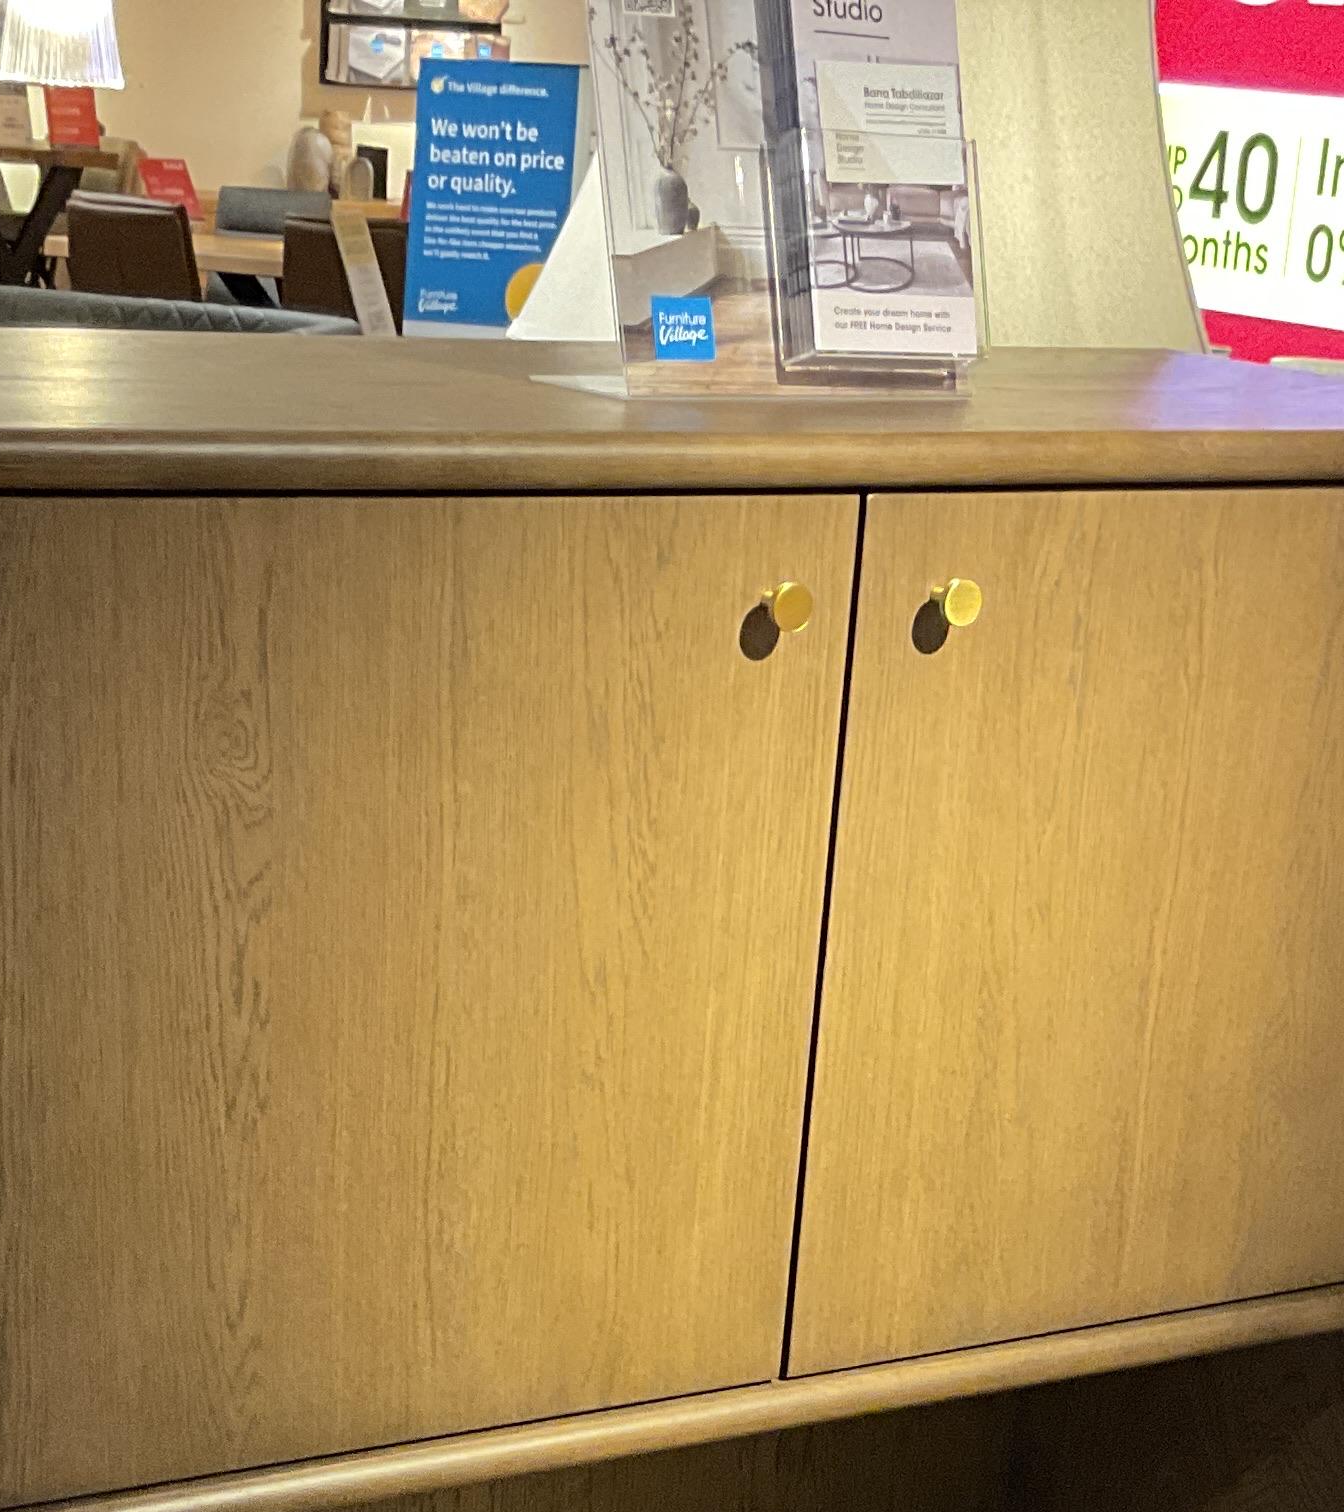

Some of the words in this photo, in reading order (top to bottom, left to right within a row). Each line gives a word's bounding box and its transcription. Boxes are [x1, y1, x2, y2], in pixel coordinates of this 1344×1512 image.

[813, 0, 883, 23] Studio
[447, 80, 465, 93] The
[466, 82, 498, 97] Village
[431, 117, 458, 137] We
[462, 121, 513, 141] won't
[516, 121, 539, 142] be
[429, 143, 490, 165] beaten
[494, 153, 517, 167] on
[520, 150, 565, 172] price
[427, 174, 448, 189] or
[450, 173, 517, 198] quality.
[1189, 130, 1279, 224] 40
[1183, 229, 1269, 275] onths
[659, 311, 707, 326] Furniture
[833, 306, 861, 315] Create
[910, 309, 933, 318] home
[659, 325, 709, 345] Village
[850, 321, 868, 330] FREE
[869, 322, 893, 331] Home
[895, 322, 922, 333] Design
[923, 323, 952, 333] Service
